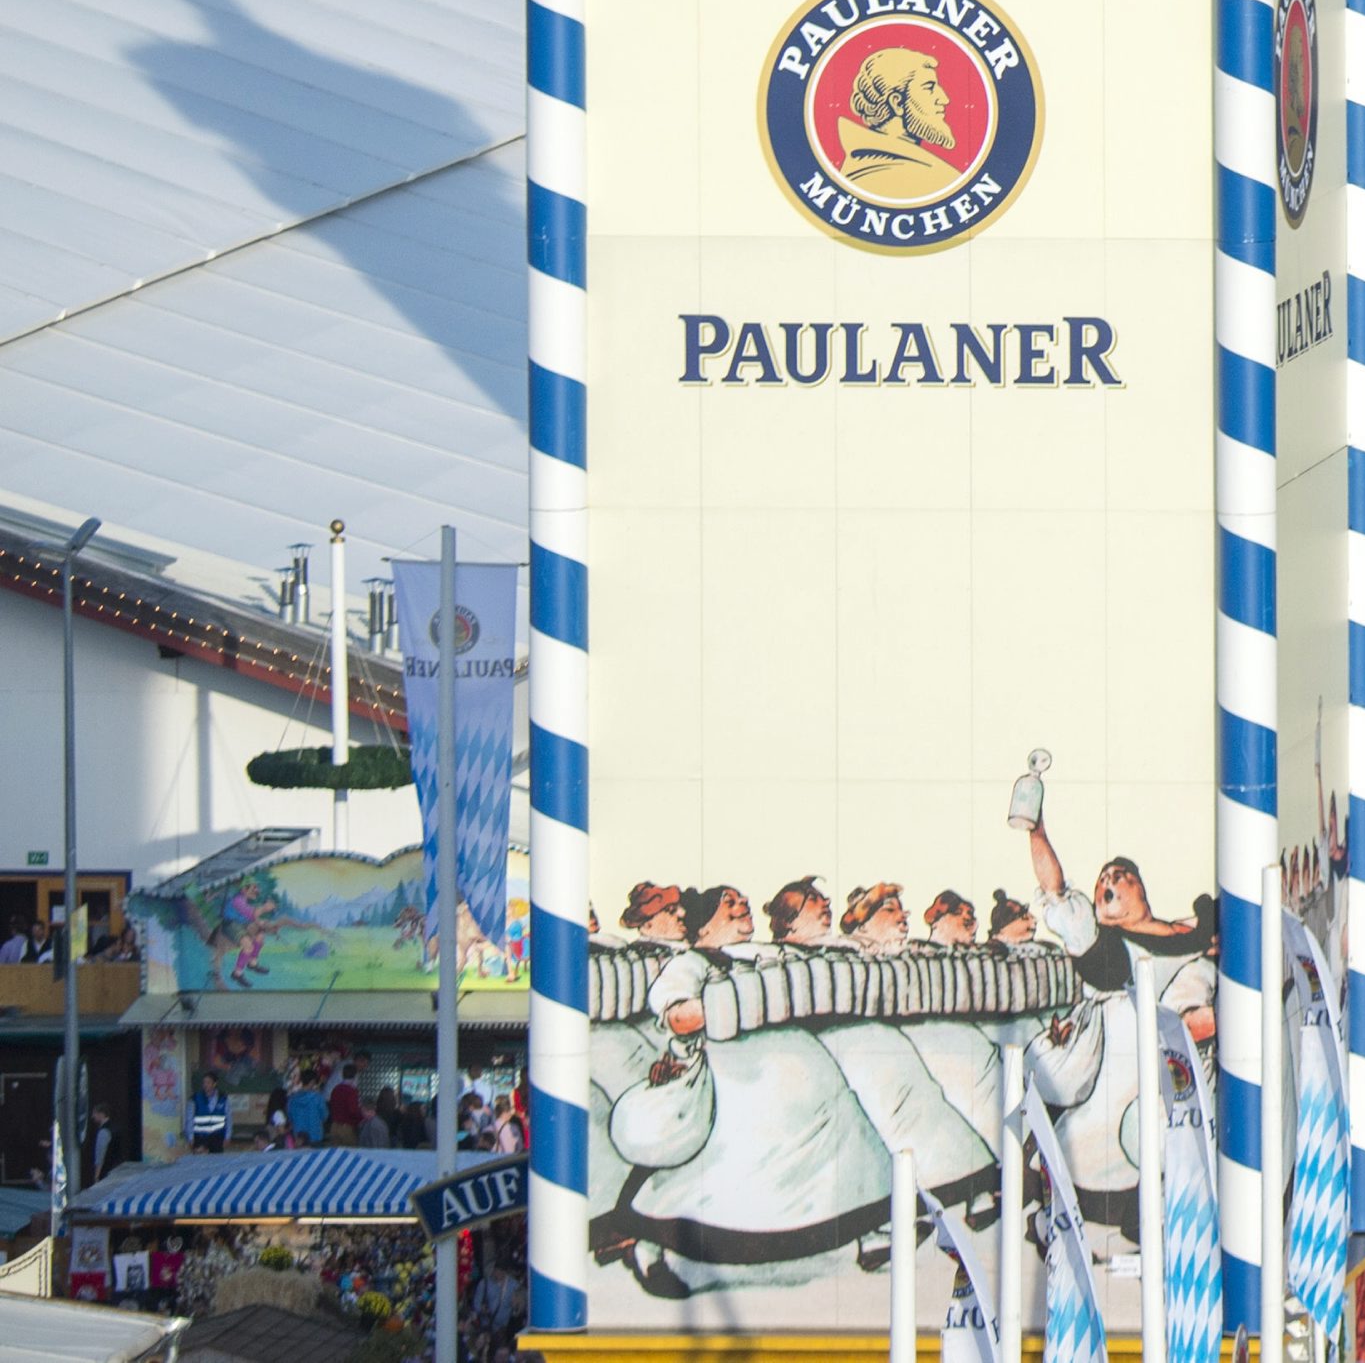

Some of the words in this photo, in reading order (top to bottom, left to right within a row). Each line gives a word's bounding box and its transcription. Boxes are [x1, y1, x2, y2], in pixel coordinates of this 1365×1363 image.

[799, 172, 1002, 240] MÜNCHEN
[678, 314, 1126, 387] PAULANER
[442, 1167, 521, 1228] AUF
